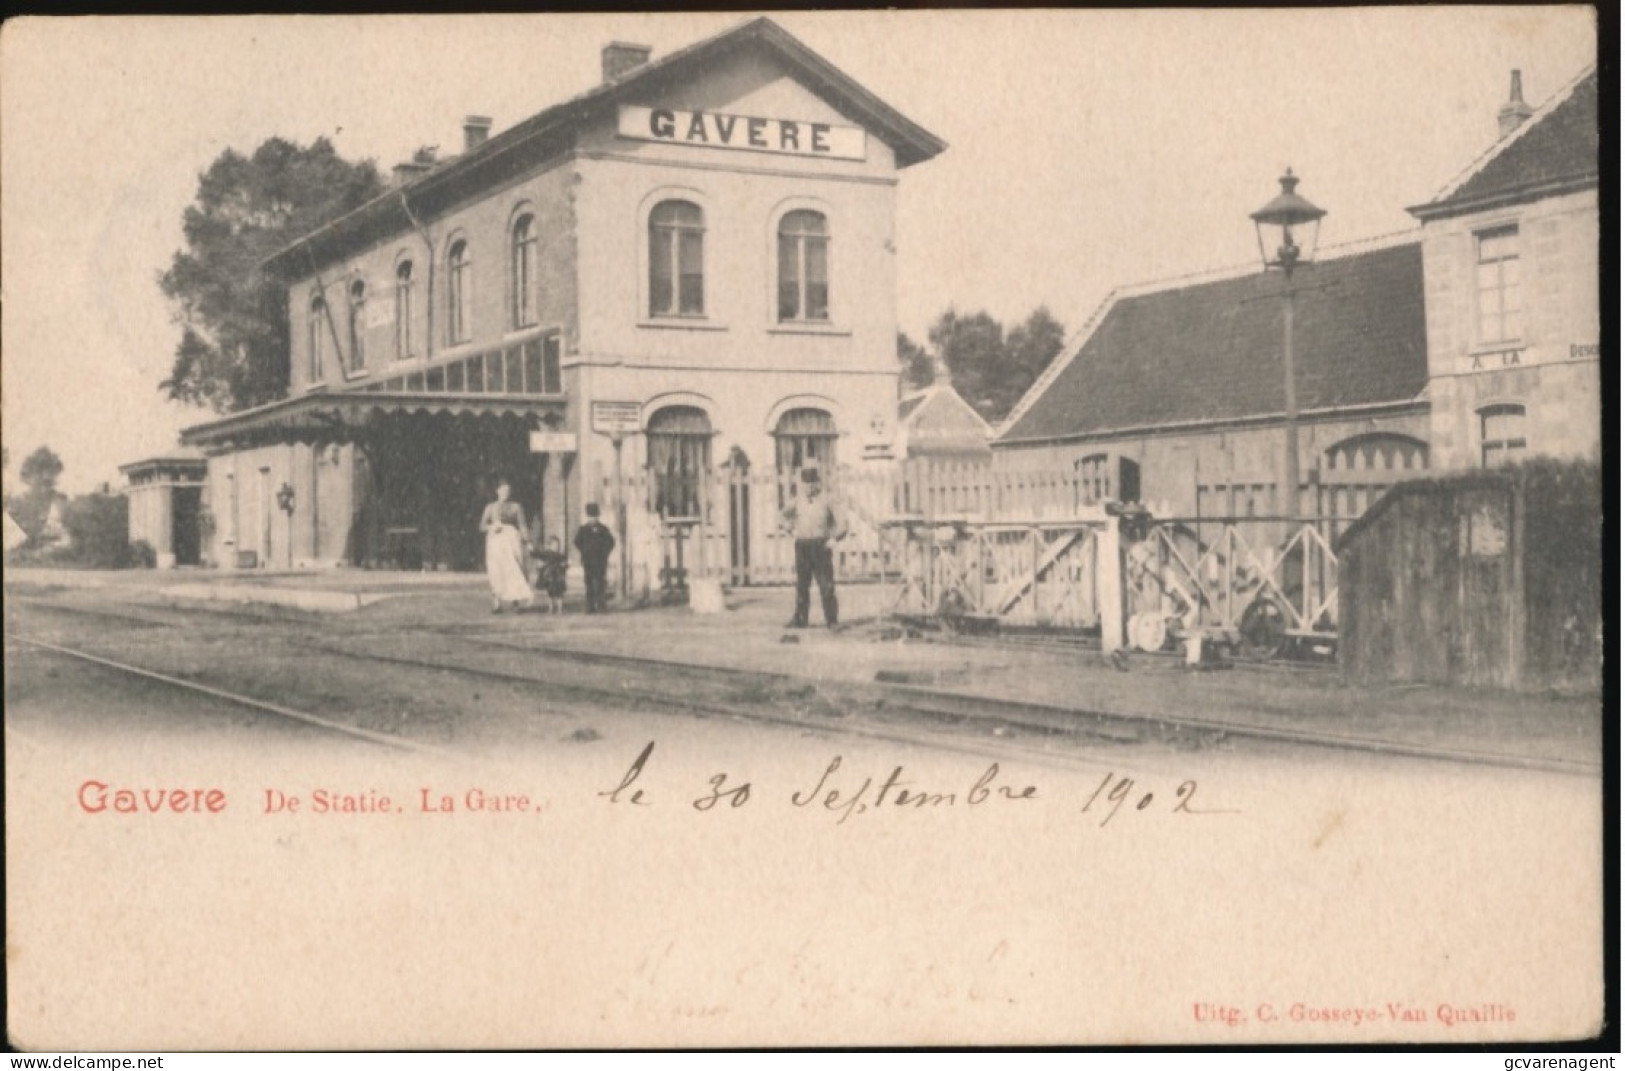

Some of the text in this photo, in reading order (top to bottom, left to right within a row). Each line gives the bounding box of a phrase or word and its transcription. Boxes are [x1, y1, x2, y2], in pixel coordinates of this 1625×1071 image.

[651, 109, 831, 152] GAVERE
[598, 741, 654, 806] le
[692, 770, 753, 809] 30
[790, 755, 1038, 824] Septembre
